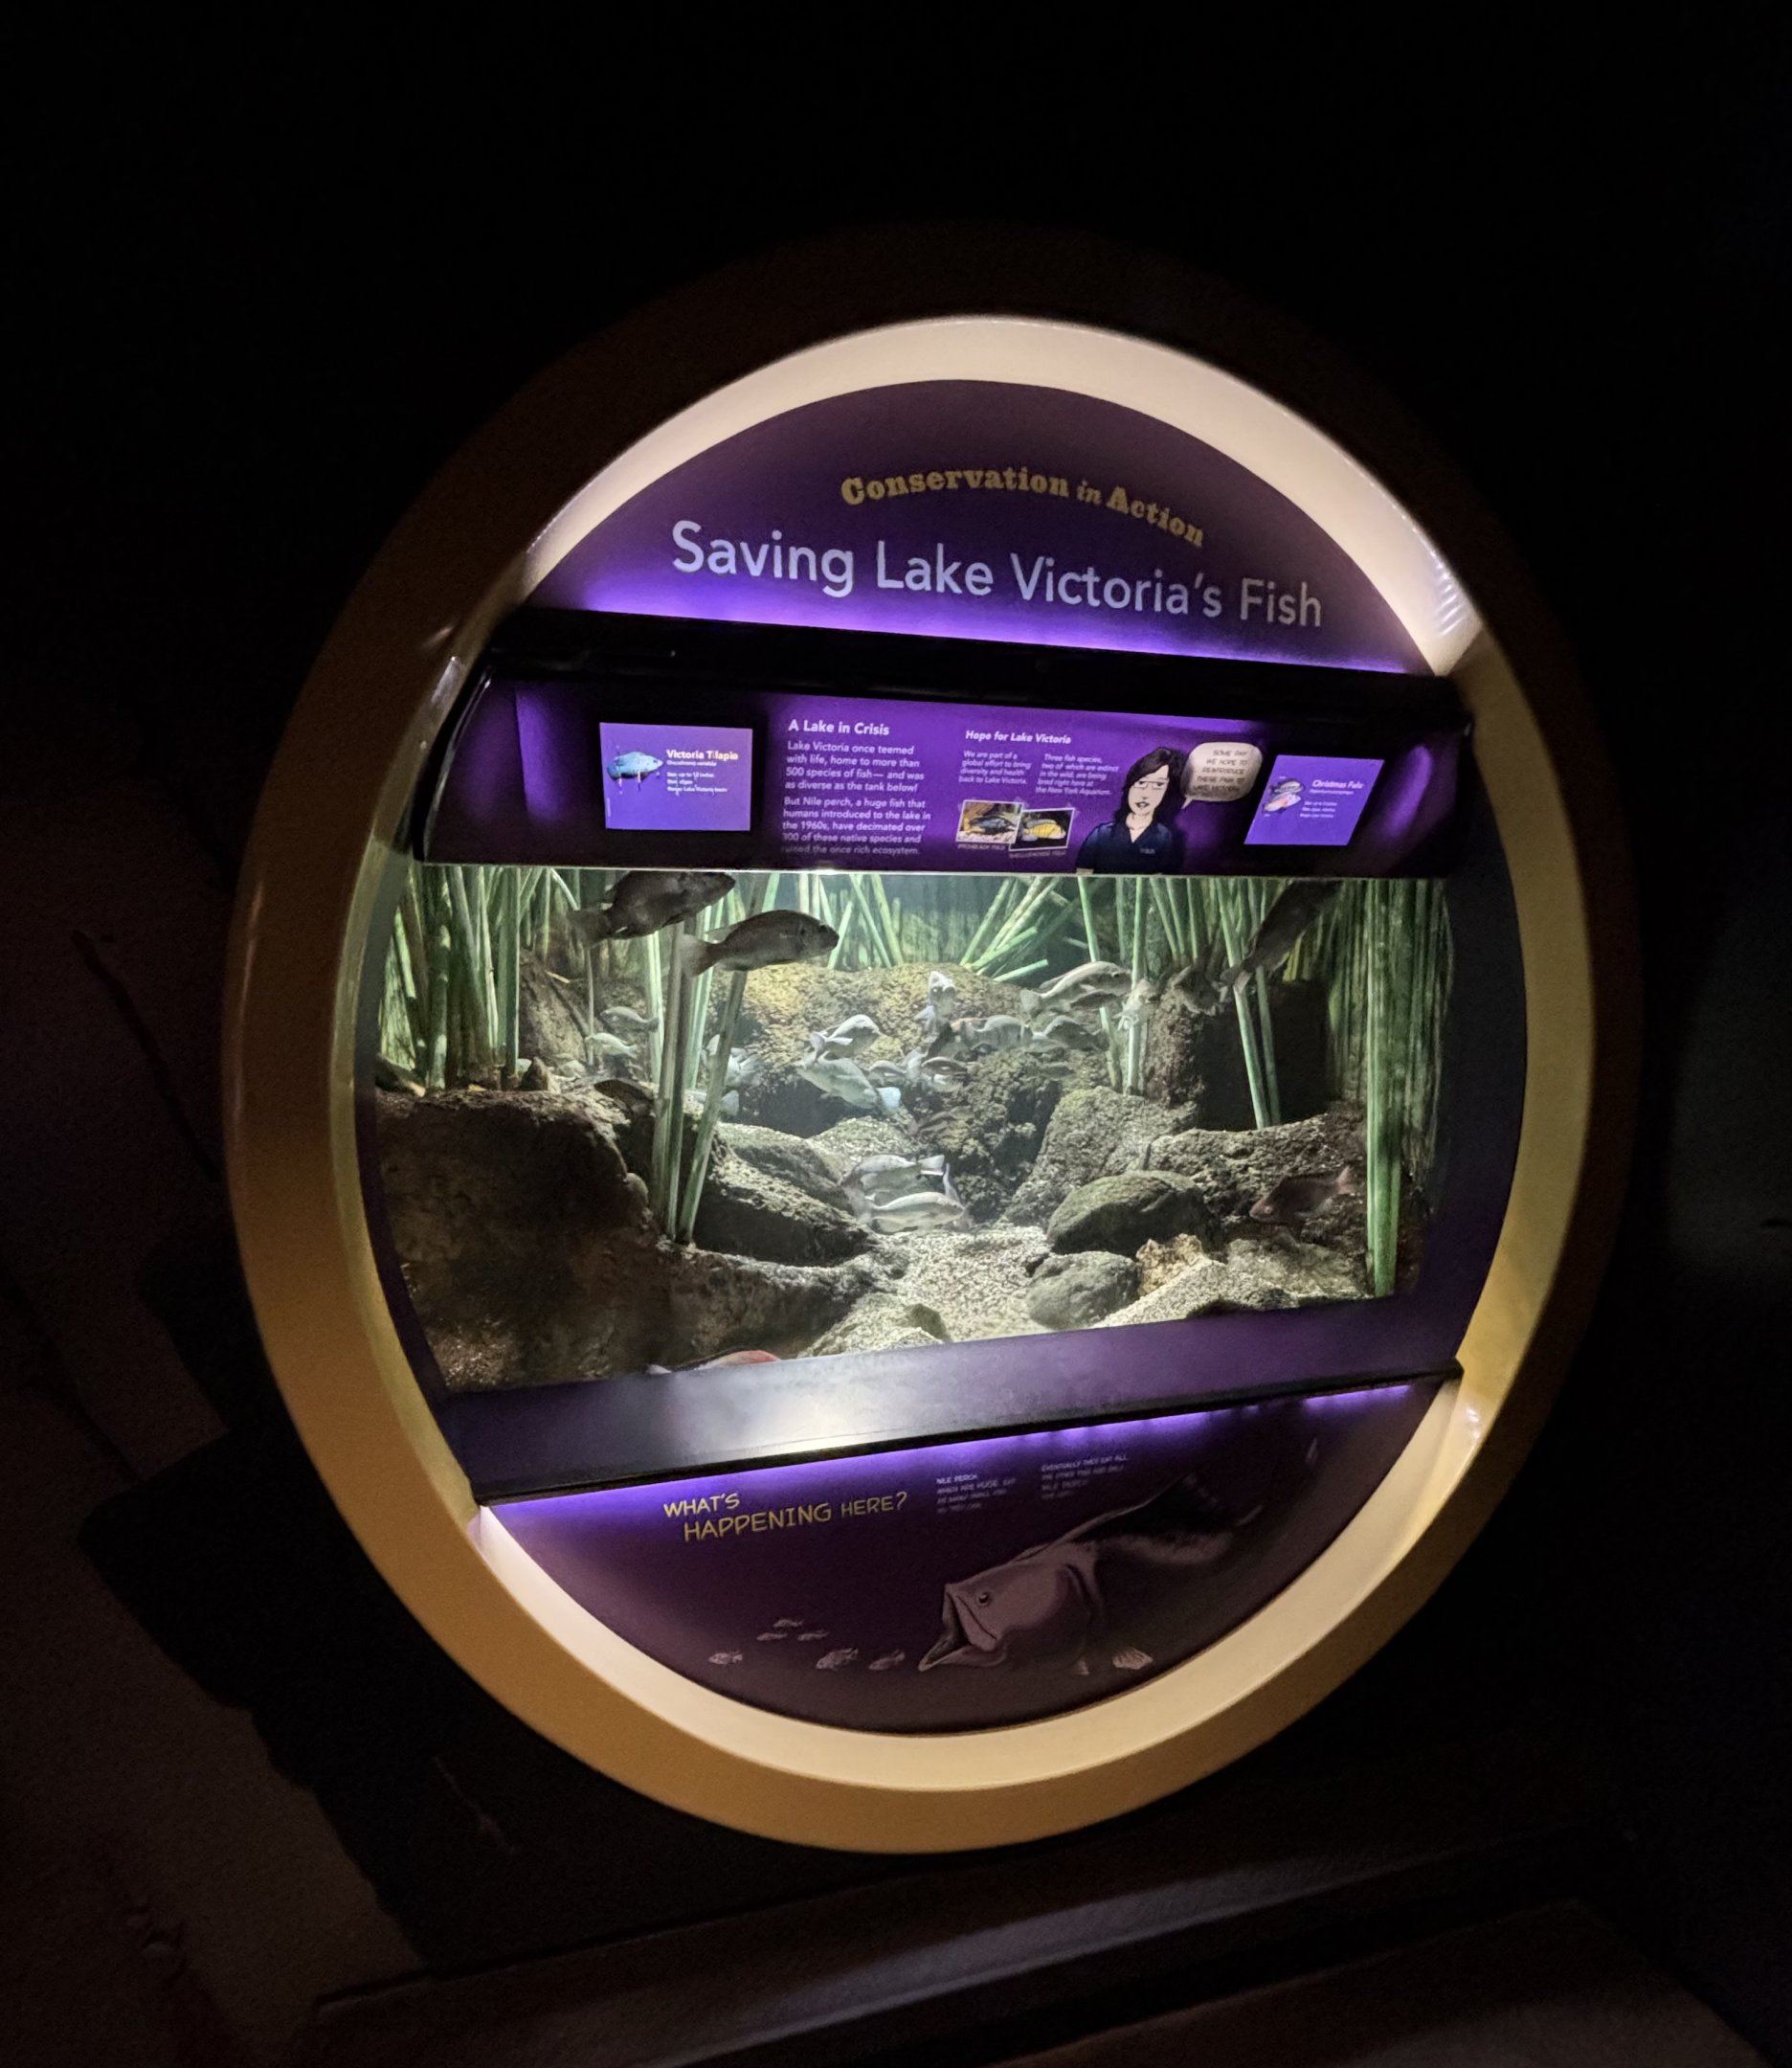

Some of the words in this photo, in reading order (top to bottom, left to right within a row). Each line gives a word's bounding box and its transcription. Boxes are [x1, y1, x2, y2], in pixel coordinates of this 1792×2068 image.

[840, 467, 1069, 506] Conservation
[1076, 482, 1102, 505] in
[1107, 487, 1205, 548] Action
[671, 520, 855, 598] Saving
[876, 541, 995, 596] Lake
[1009, 551, 1222, 618] Victoria's
[1241, 576, 1323, 628] Fish
[788, 719, 798, 731] A
[803, 720, 834, 732] Lake
[839, 722, 850, 733] in
[854, 722, 889, 735] Crisis
[965, 731, 992, 742] Hope
[995, 731, 1008, 741] for
[1011, 732, 1033, 742] Lake
[1036, 733, 1071, 744] Victoria
[788, 741, 810, 751] Lake
[813, 741, 849, 752] Victoria
[852, 745, 875, 753] once
[878, 746, 914, 754] teemed
[666, 749, 704, 759] Victoria
[706, 751, 739, 761] Tilapia
[787, 754, 807, 763] with
[810, 754, 828, 765] life,
[831, 755, 857, 765] home
[861, 756, 869, 765] to
[900, 757, 920, 767] than
[962, 759, 983, 768] global
[786, 767, 803, 776] 500
[806, 769, 841, 778] species
[843, 769, 855, 777] of
[887, 771, 904, 779] and
[798, 780, 832, 790] diverse
[847, 781, 862, 790] the
[865, 782, 884, 791] tank
[784, 797, 800, 805] But
[803, 797, 821, 806] Nile
[824, 798, 853, 807] perch,
[864, 798, 886, 809] huge
[889, 798, 905, 807] fish
[907, 799, 925, 808] that
[783, 809, 818, 818] humans
[821, 810, 870, 819] introduced
[885, 811, 900, 820] the
[902, 811, 919, 820] lake
[923, 811, 931, 820] in
[801, 820, 829, 830] 1960s,
[833, 821, 854, 830] have
[856, 822, 903, 831] decimated
[801, 833, 811, 842] of
[814, 833, 838, 842] these
[840, 834, 867, 843] native
[869, 835, 902, 843] species
[812, 844, 827, 854] the
[854, 845, 870, 854] rich
[663, 1493, 740, 1518] WHAT'S
[683, 1503, 832, 1542] HAPPENING
[840, 1491, 907, 1518] HERE?
